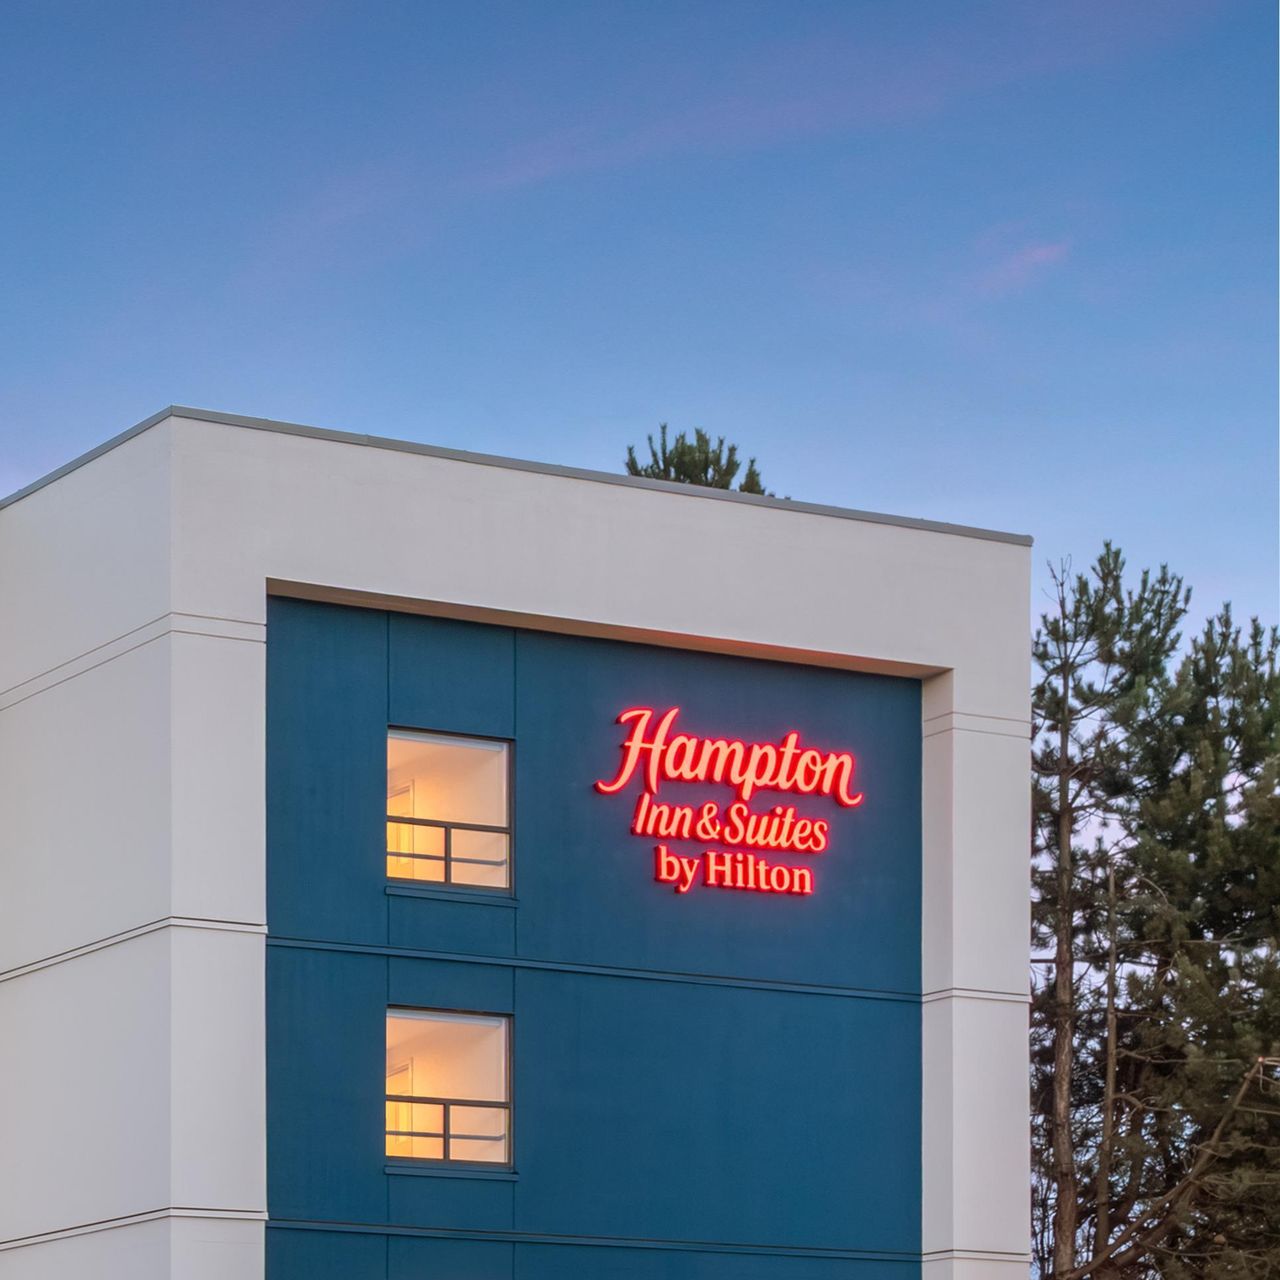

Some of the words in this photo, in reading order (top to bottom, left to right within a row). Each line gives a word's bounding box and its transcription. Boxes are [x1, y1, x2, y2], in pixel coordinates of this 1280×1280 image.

[594, 706, 863, 807] Hampton
[656, 844, 699, 893] by
[705, 851, 813, 894] Hilton
